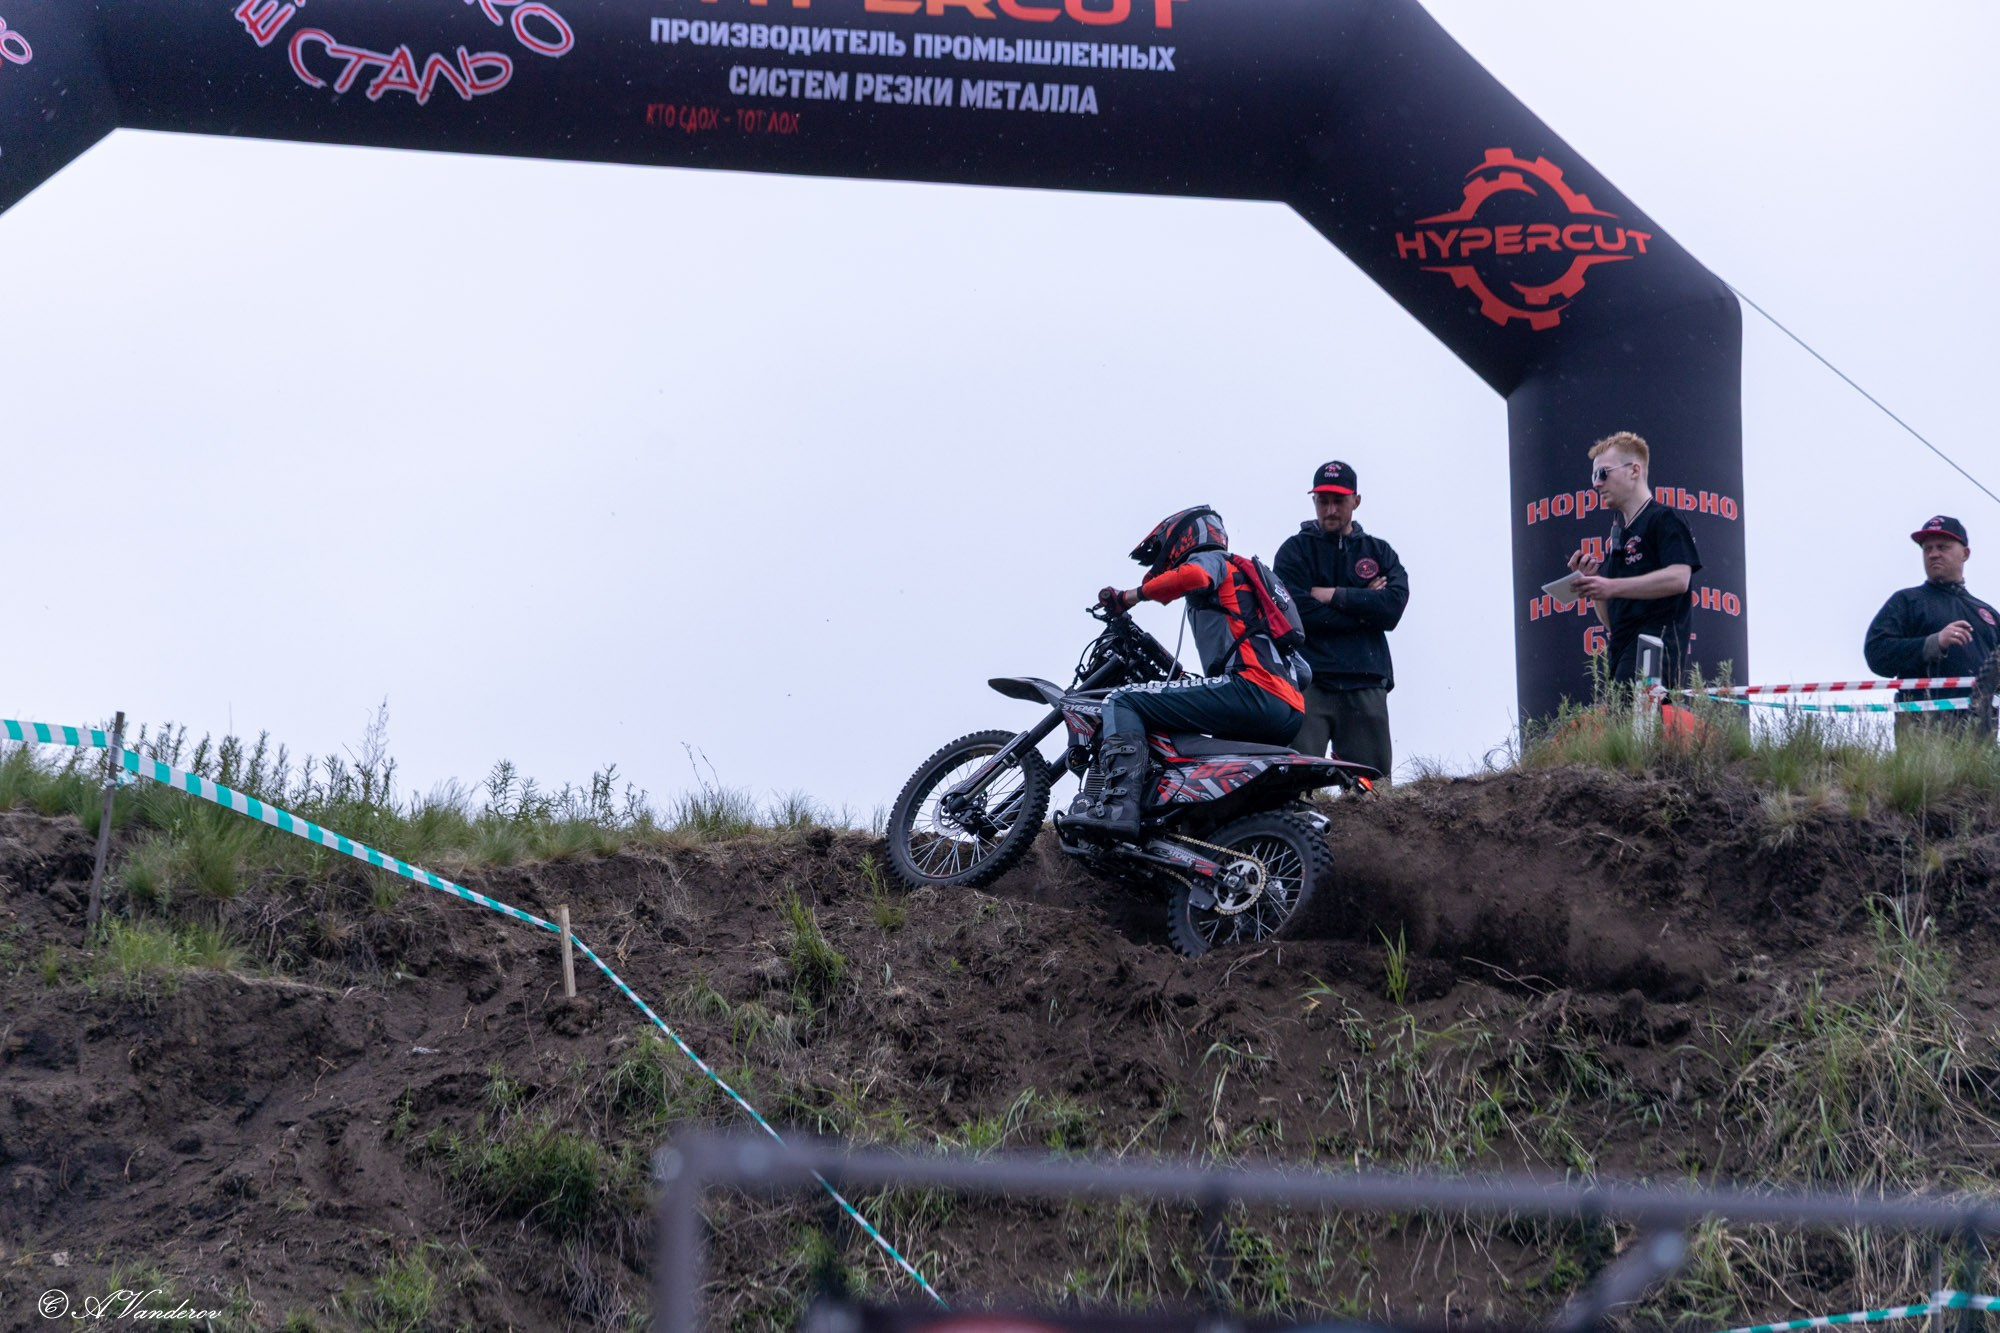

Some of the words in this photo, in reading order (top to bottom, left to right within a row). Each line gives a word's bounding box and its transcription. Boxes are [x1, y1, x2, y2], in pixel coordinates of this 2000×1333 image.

[650, 17, 906, 57] ПРОИЗВОДИТЕЛЬ
[913, 33, 1176, 72] ПРОМЫШЛЕННЫХ
[728, 65, 849, 102] СИСТЕМ
[854, 72, 953, 107] РЕЗКИ
[960, 77, 1099, 116] МЕТАЛЛА
[645, 103, 676, 128] КТО
[679, 105, 720, 134] СДОХ
[737, 108, 764, 133] ТОТ
[1395, 223, 1652, 259] HYPERCUT
